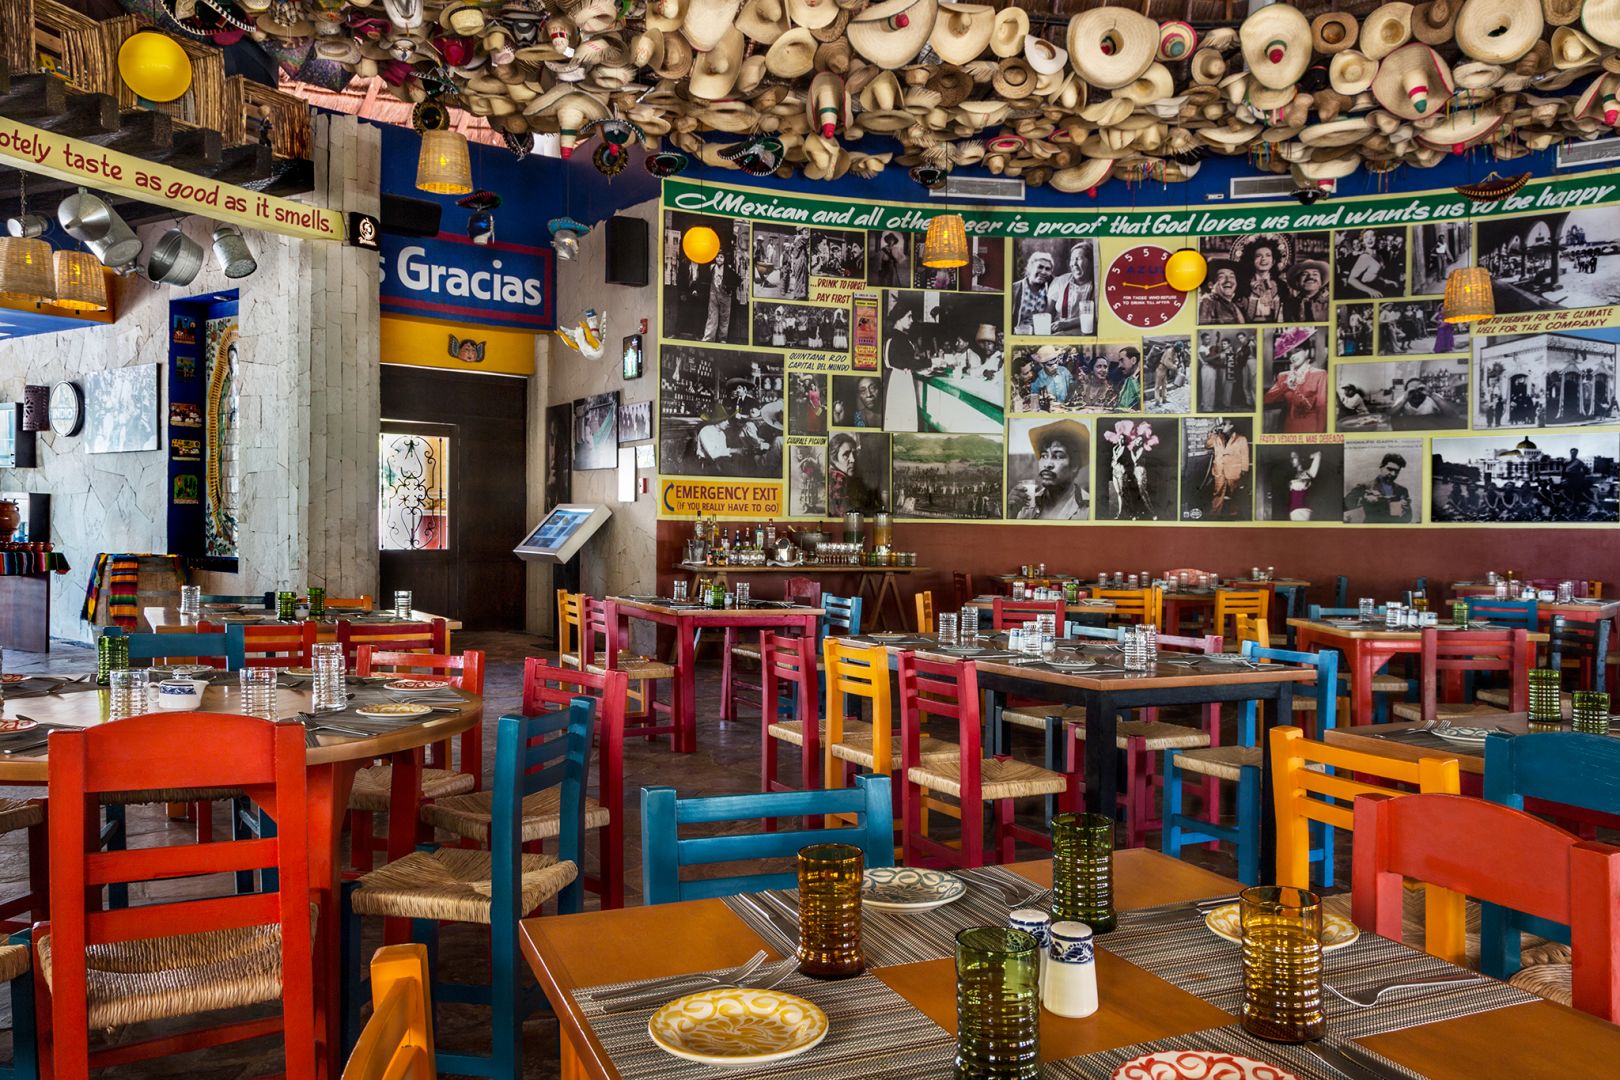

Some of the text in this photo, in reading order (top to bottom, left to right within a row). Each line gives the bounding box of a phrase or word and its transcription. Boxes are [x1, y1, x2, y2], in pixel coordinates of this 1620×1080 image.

[0, 129, 334, 234] otely taste as good as it smells.
[674, 190, 809, 221] Mexican
[812, 206, 856, 224] and
[853, 206, 885, 226] all
[886, 210, 932, 231] othe
[957, 212, 1004, 234] eer
[1006, 215, 1029, 233] is
[1033, 216, 1108, 238] proof
[1110, 215, 1152, 234] that
[1152, 214, 1196, 234] God
[1196, 214, 1264, 232] loves
[1264, 216, 1290, 228] us
[1293, 205, 1345, 228] and
[1344, 200, 1431, 224] wants
[1432, 204, 1466, 218] us
[1501, 192, 1535, 211] be
[1535, 184, 1616, 208] happy
[1143, 248, 1150, 257] 5
[1160, 252, 1169, 260] 5
[1124, 254, 1133, 262] 5
[397, 246, 542, 306] Gracias
[840, 280, 847, 289] TO
[847, 280, 866, 290] FORGET
[831, 294, 851, 304] FIRST
[1174, 300, 1182, 308] 5
[1112, 302, 1122, 310] 5
[1126, 313, 1134, 321] 5
[1160, 312, 1168, 322] 5
[1502, 314, 1534, 324] HEAVEN
[1534, 312, 1551, 322] FOR
[1552, 312, 1570, 320] THE
[1573, 308, 1614, 318] CLIMATE
[1144, 317, 1150, 326] 5
[1476, 318, 1608, 334] HELL FOR THE COMPANY
[789, 352, 826, 361] QUINTANA
[828, 354, 847, 362] ROO
[788, 362, 814, 370] CAPITAL
[675, 484, 778, 500] EMERGENCY EXIT
[688, 501, 700, 511] YOU
[702, 502, 726, 512] REALLY
[728, 502, 750, 512] HAVE
[752, 502, 762, 512] TO
[764, 502, 780, 513] GO)
